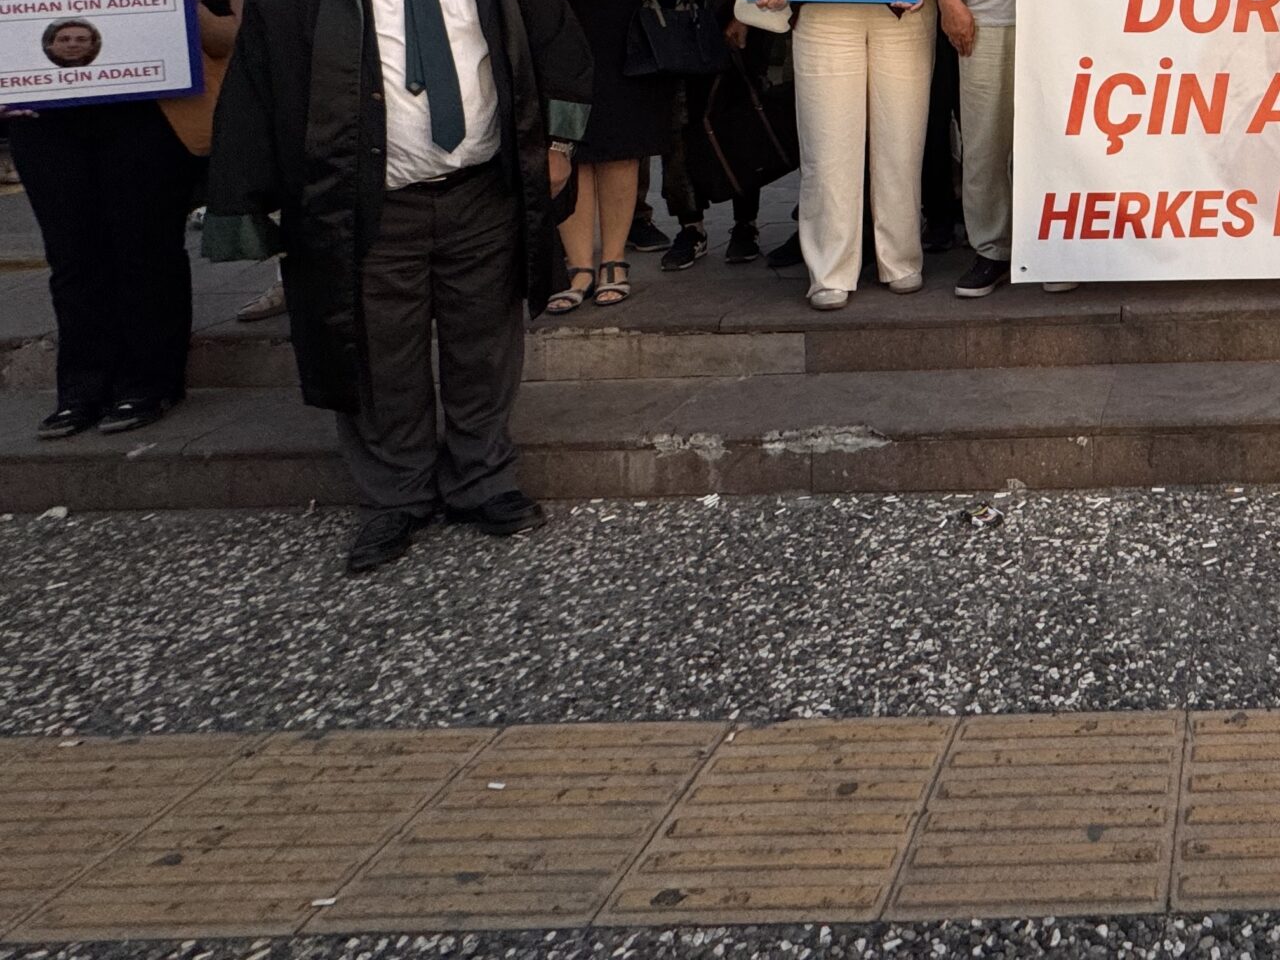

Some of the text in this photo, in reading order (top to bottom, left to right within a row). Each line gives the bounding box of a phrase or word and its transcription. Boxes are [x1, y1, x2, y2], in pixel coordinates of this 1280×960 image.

[0, 1, 62, 15] UKHAN
[0, 65, 161, 88] ERKES İÇİN ADALET
[1065, 56, 1230, 155] İÇİN
[1037, 189, 1257, 241] HERKES
